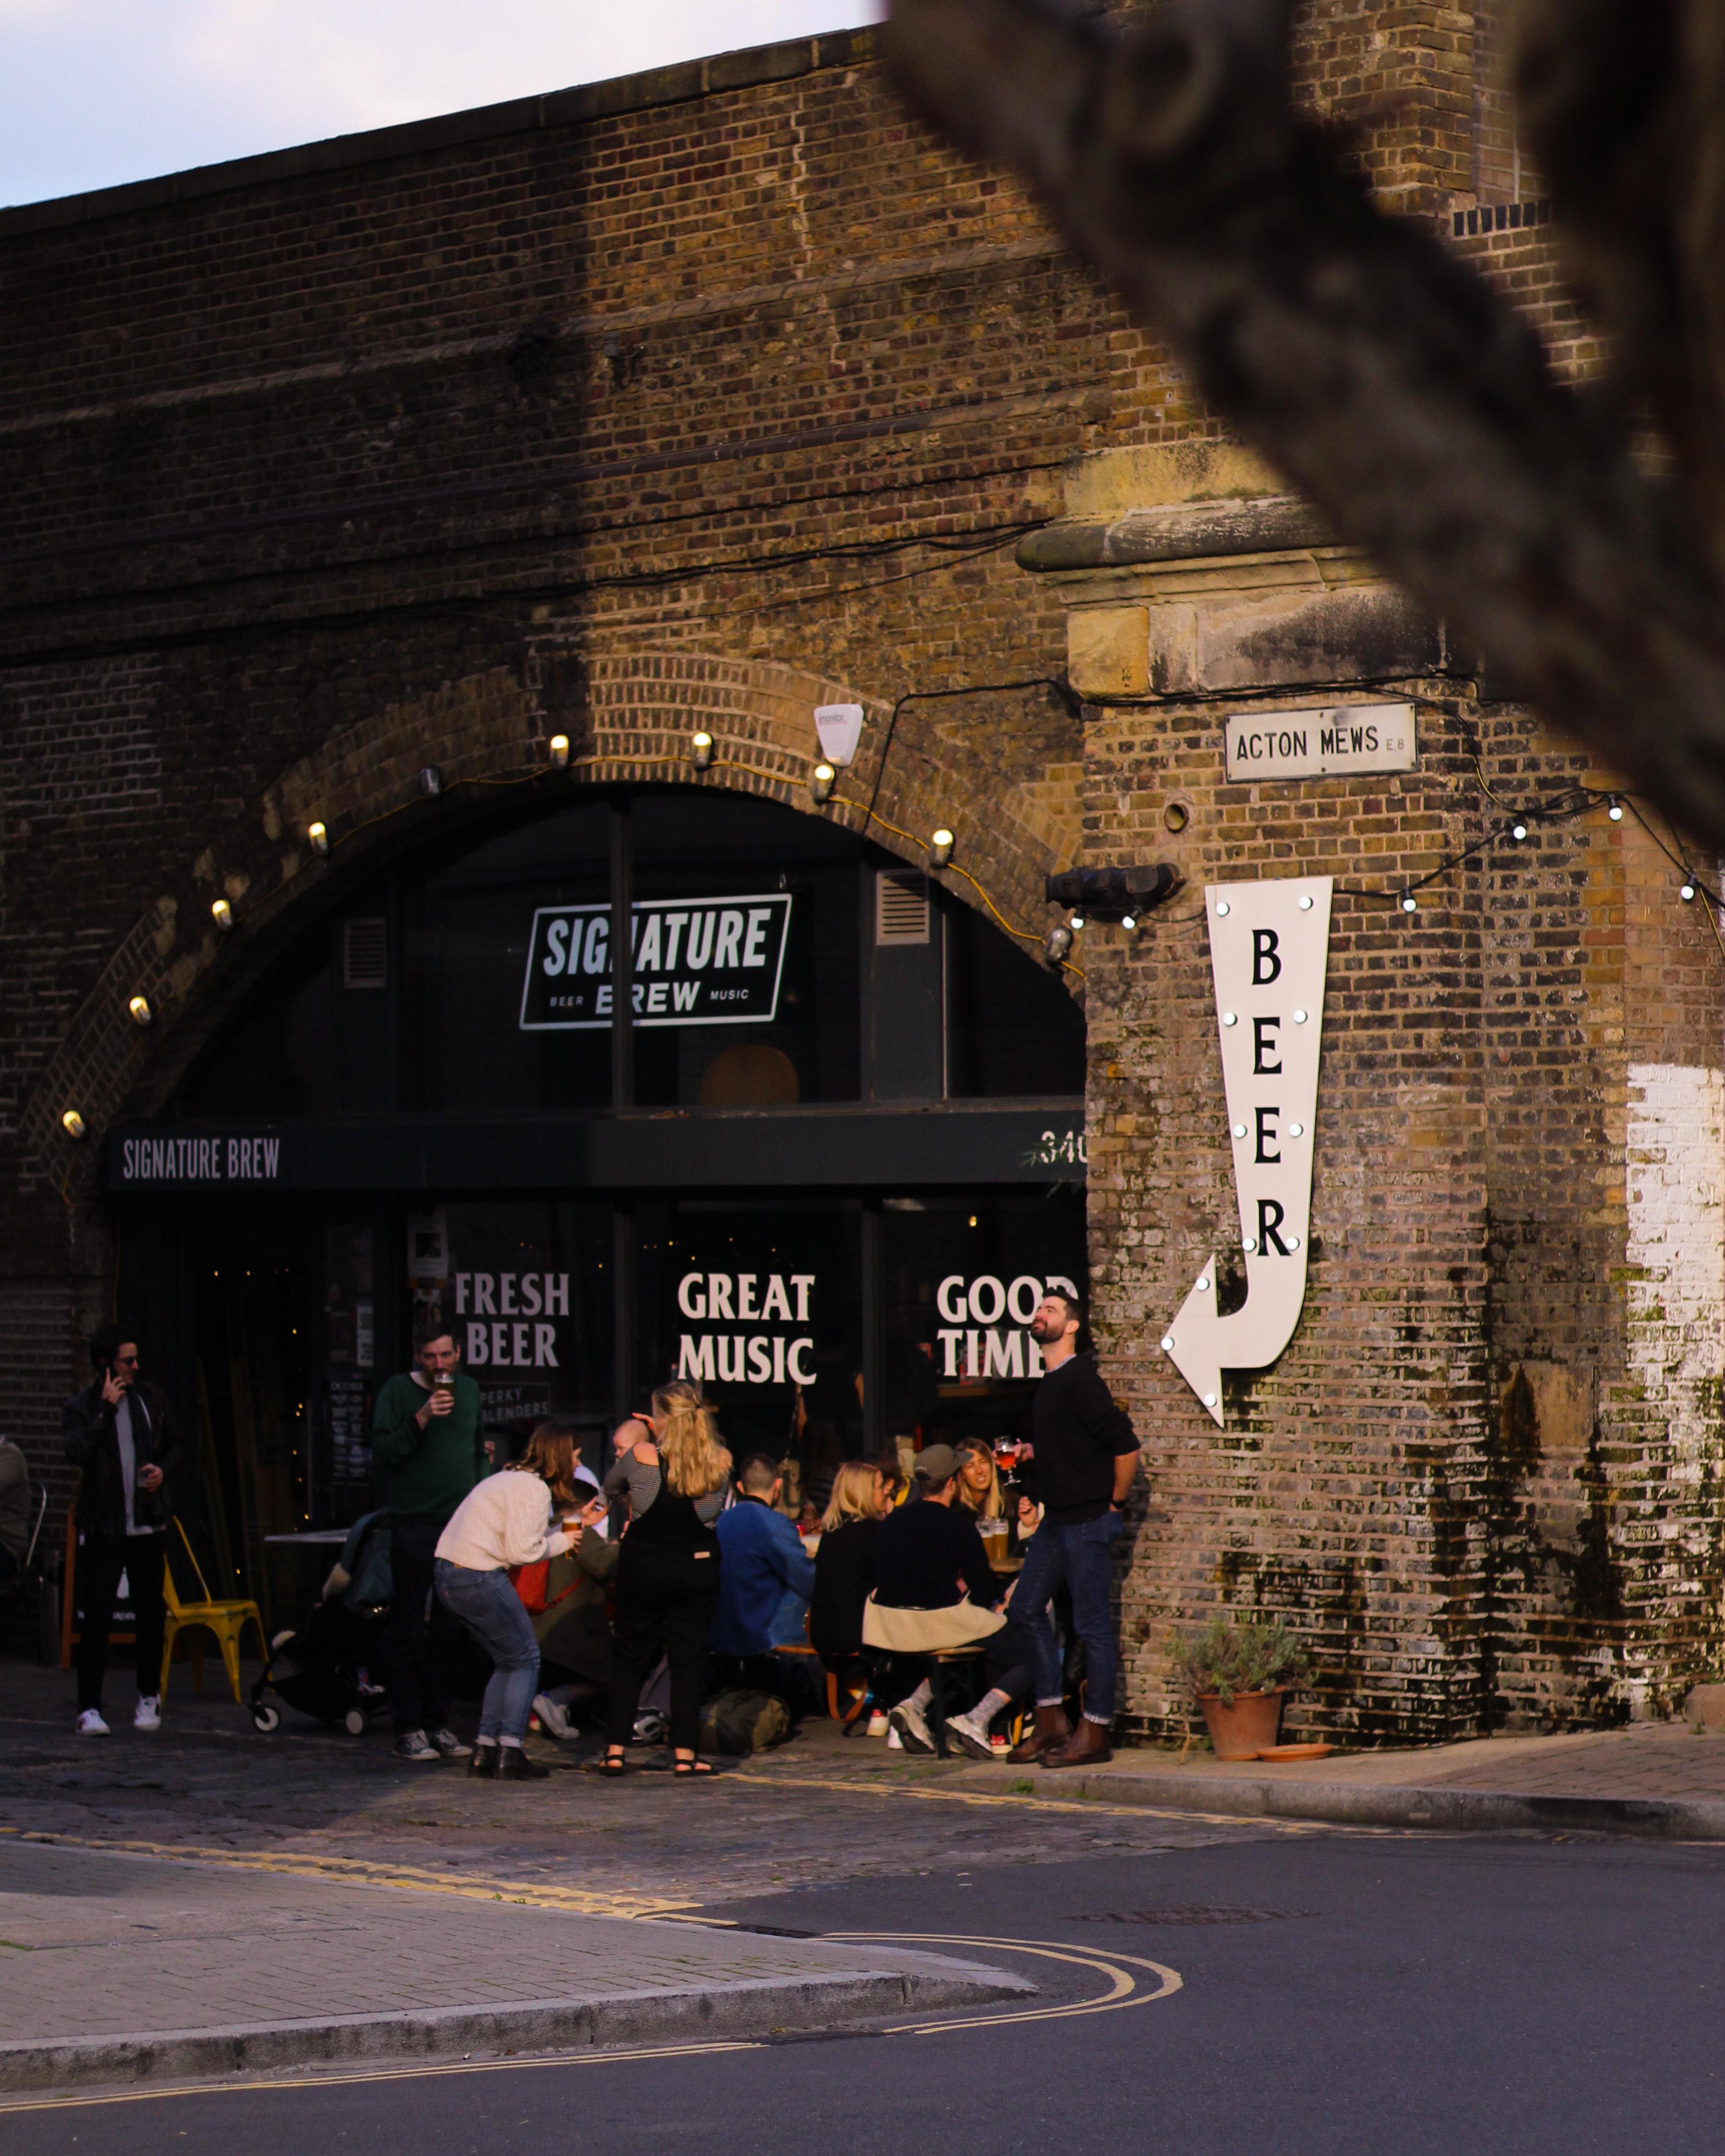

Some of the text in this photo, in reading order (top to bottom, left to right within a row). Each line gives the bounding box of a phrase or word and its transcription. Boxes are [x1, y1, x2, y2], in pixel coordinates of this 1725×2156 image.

[1237, 731, 1307, 760] ACTON
[1321, 726, 1379, 755] MEWS
[549, 995, 584, 1007] BEER
[709, 989, 749, 1000] MUSIC
[1251, 929, 1292, 1256] BEER
[123, 1138, 279, 1179] SIGNATURE BREW
[455, 1272, 570, 1316] FRESH
[678, 1273, 816, 1321] GREAT
[466, 1322, 559, 1367] BEER
[677, 1334, 817, 1385] MUSIC
[479, 1387, 522, 1405] PERKY
